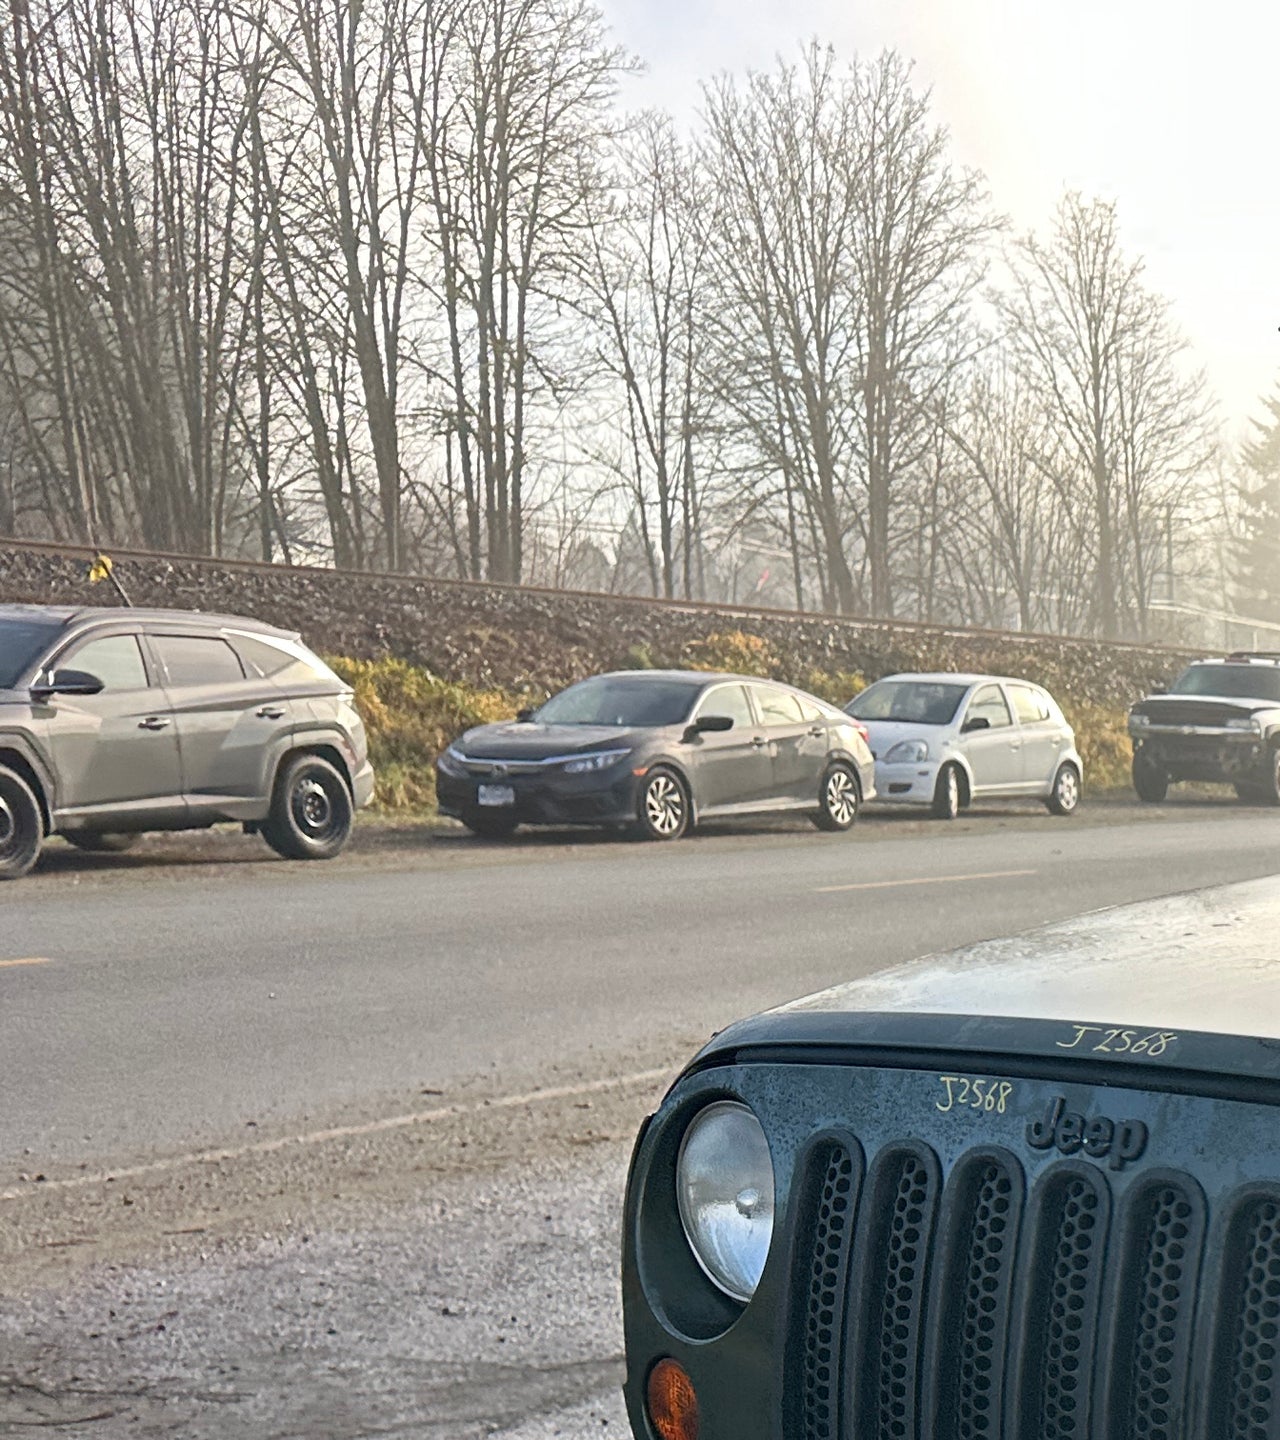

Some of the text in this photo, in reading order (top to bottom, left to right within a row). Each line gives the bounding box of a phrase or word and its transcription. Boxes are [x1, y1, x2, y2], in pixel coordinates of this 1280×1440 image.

[1056, 1024, 1178, 1056] J2568
[935, 1075, 1012, 1113] J2568
[1024, 1096, 1149, 1172] Jeep
